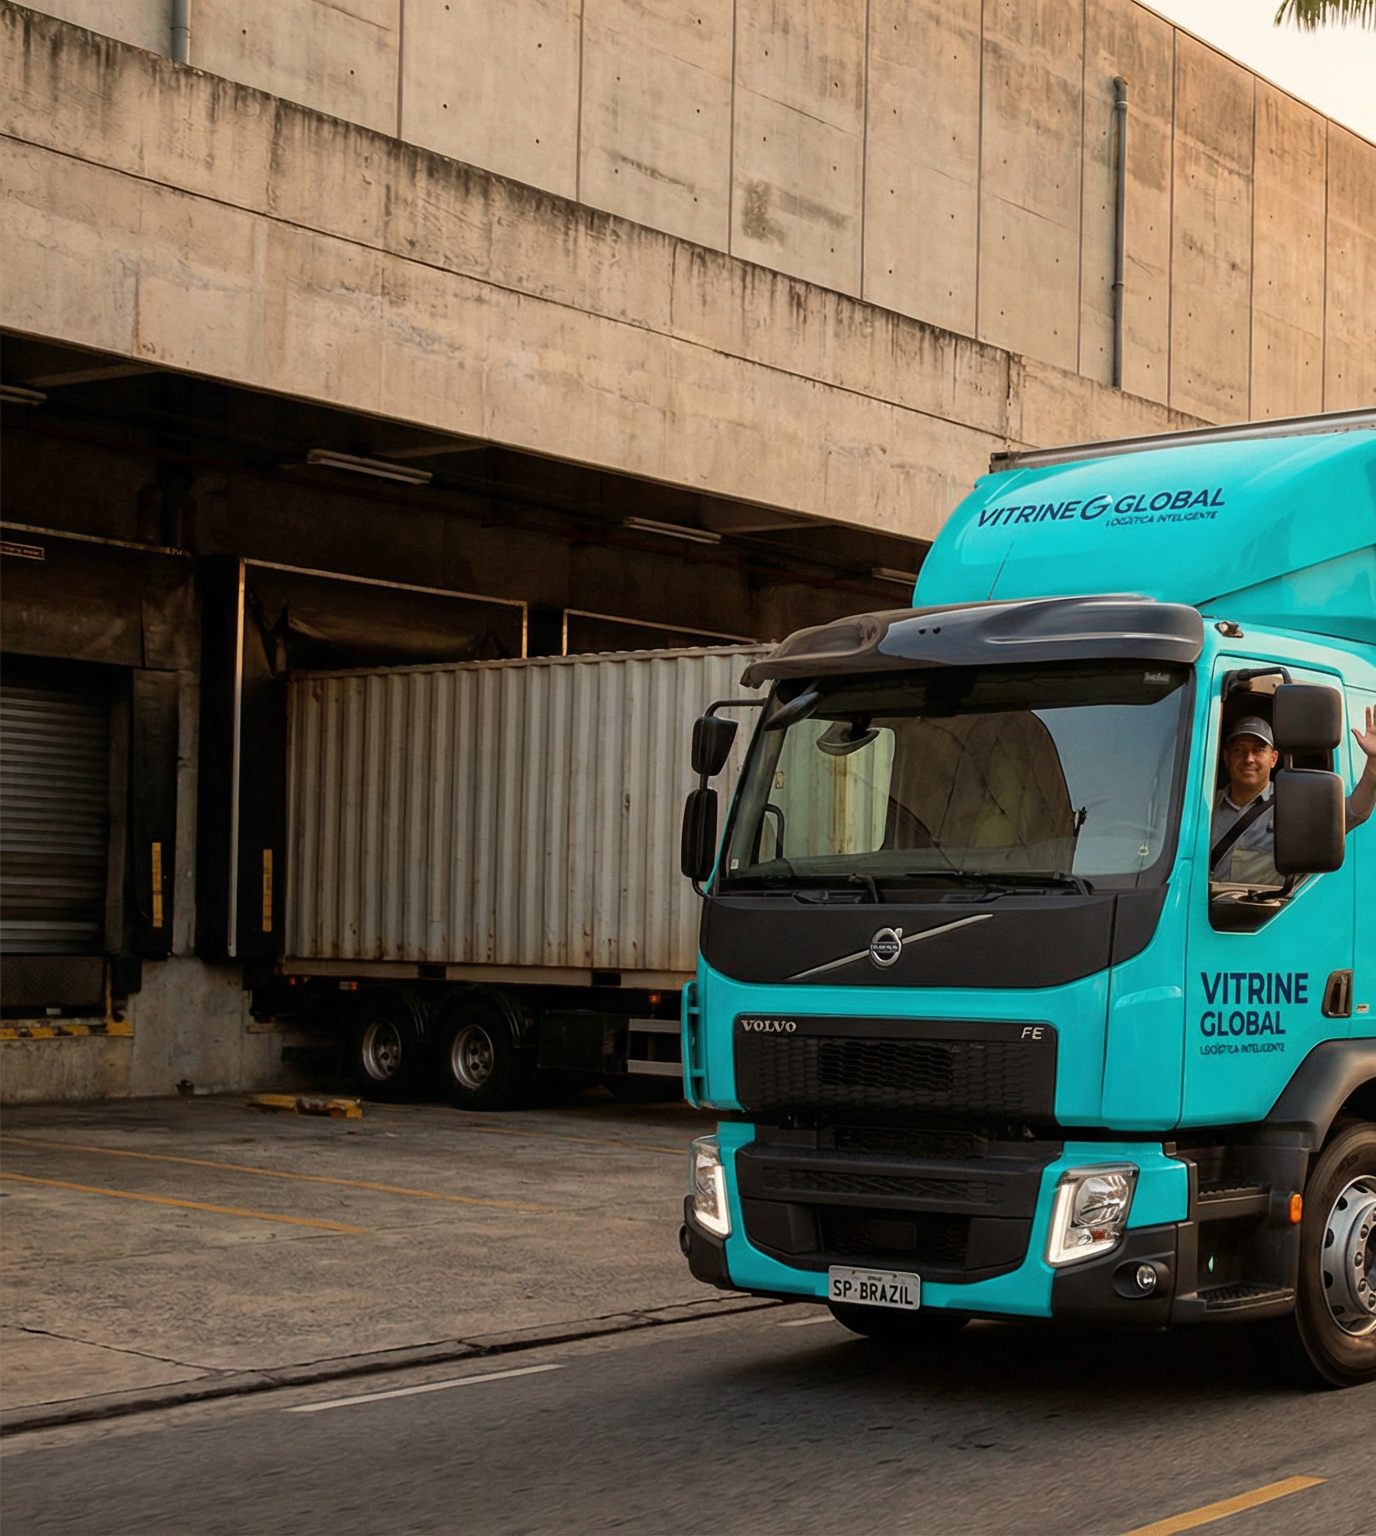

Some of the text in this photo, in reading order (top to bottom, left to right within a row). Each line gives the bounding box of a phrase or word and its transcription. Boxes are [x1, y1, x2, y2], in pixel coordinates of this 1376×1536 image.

[977, 500, 1082, 528] VITRINE
[1113, 487, 1226, 514] GLOBAL
[1200, 971, 1309, 1005] VITRINE
[740, 1019, 797, 1033] VOLVO
[1020, 1026, 1045, 1040] FE
[1199, 1010, 1287, 1037] GLOBAL
